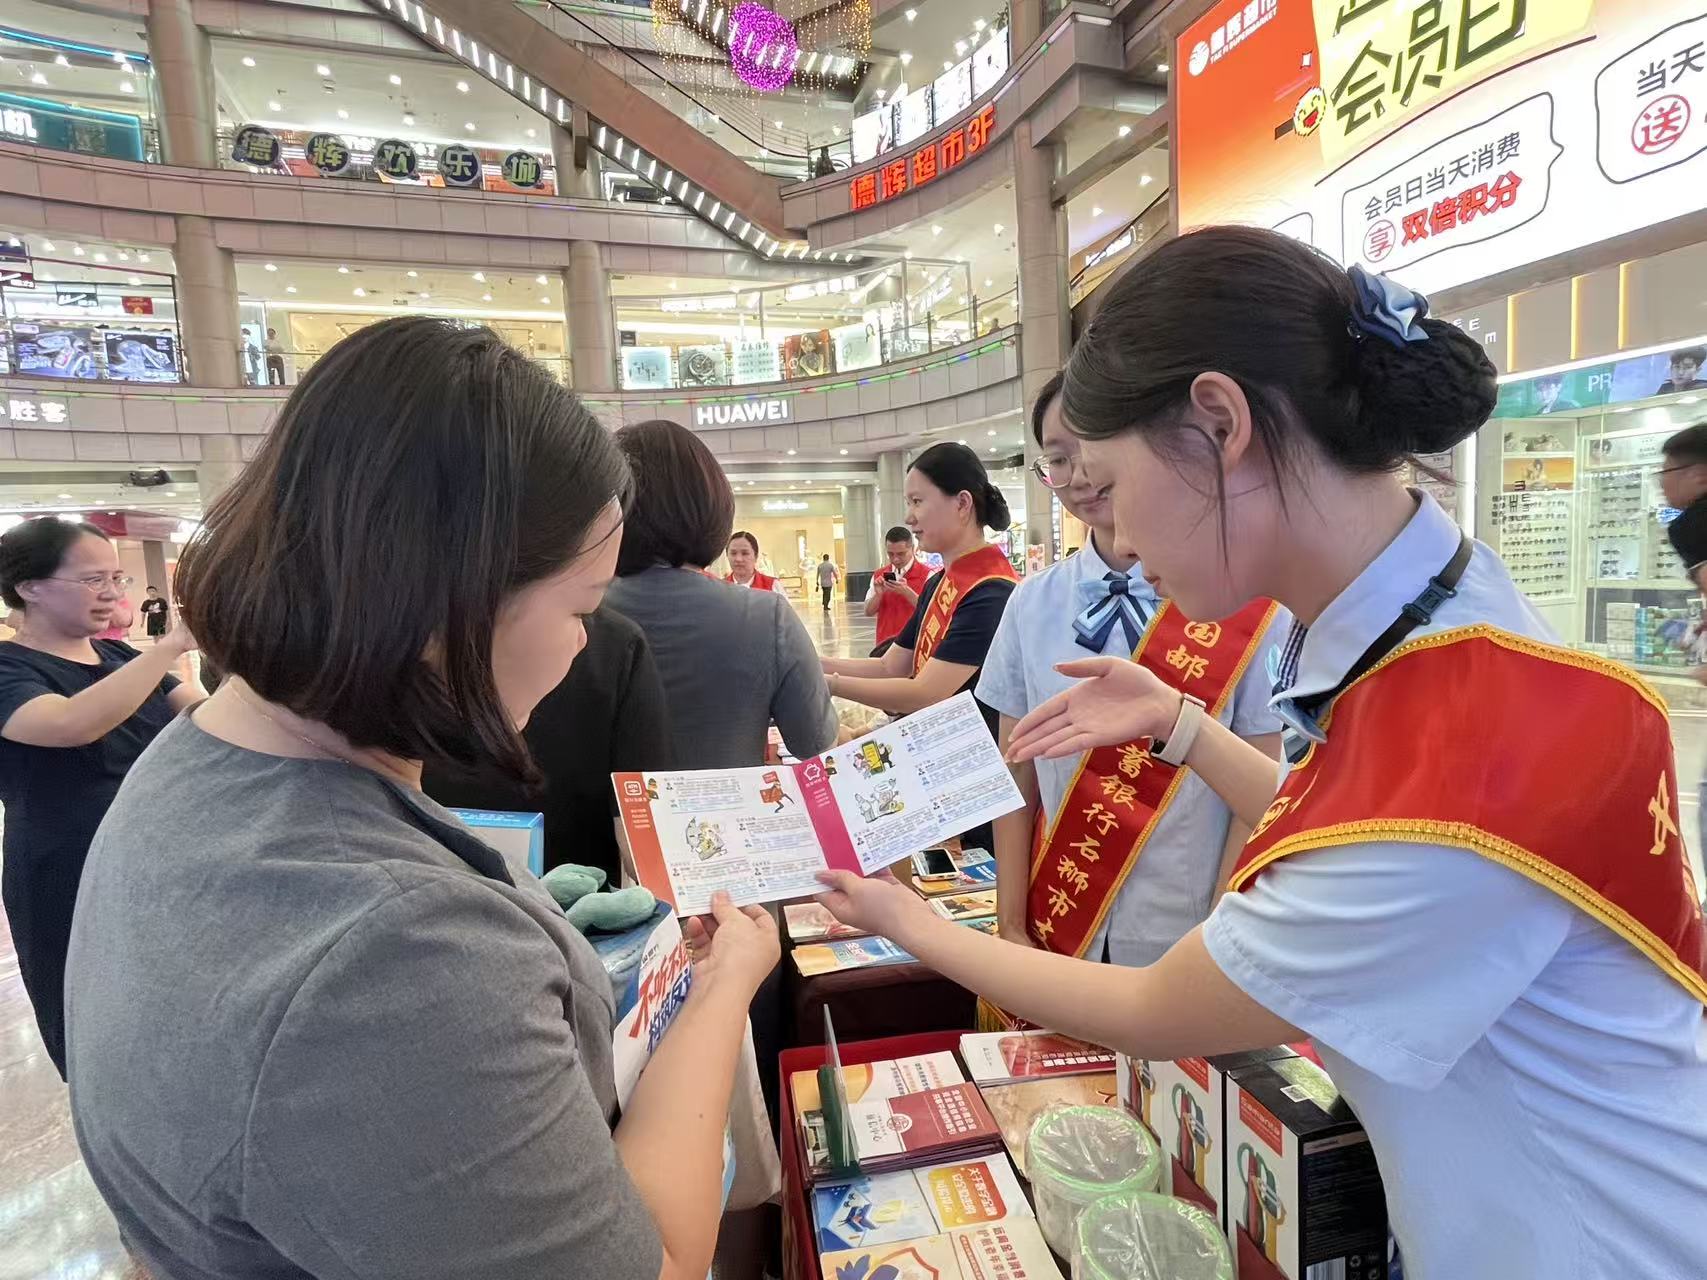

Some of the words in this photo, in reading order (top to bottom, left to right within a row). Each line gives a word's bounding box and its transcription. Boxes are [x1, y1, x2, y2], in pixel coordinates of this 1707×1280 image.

[1638, 98, 1686, 154] 送
[246, 129, 539, 184] 德辉欢乐城
[851, 104, 995, 210] 德辉超市3F
[1364, 131, 1520, 221] 会员日当天消费
[1366, 222, 1393, 260] 享
[1402, 171, 1522, 247] 双倍积分
[697, 400, 788, 425] HUAWEI
[968, 1168, 998, 1216] 关于数字金融
